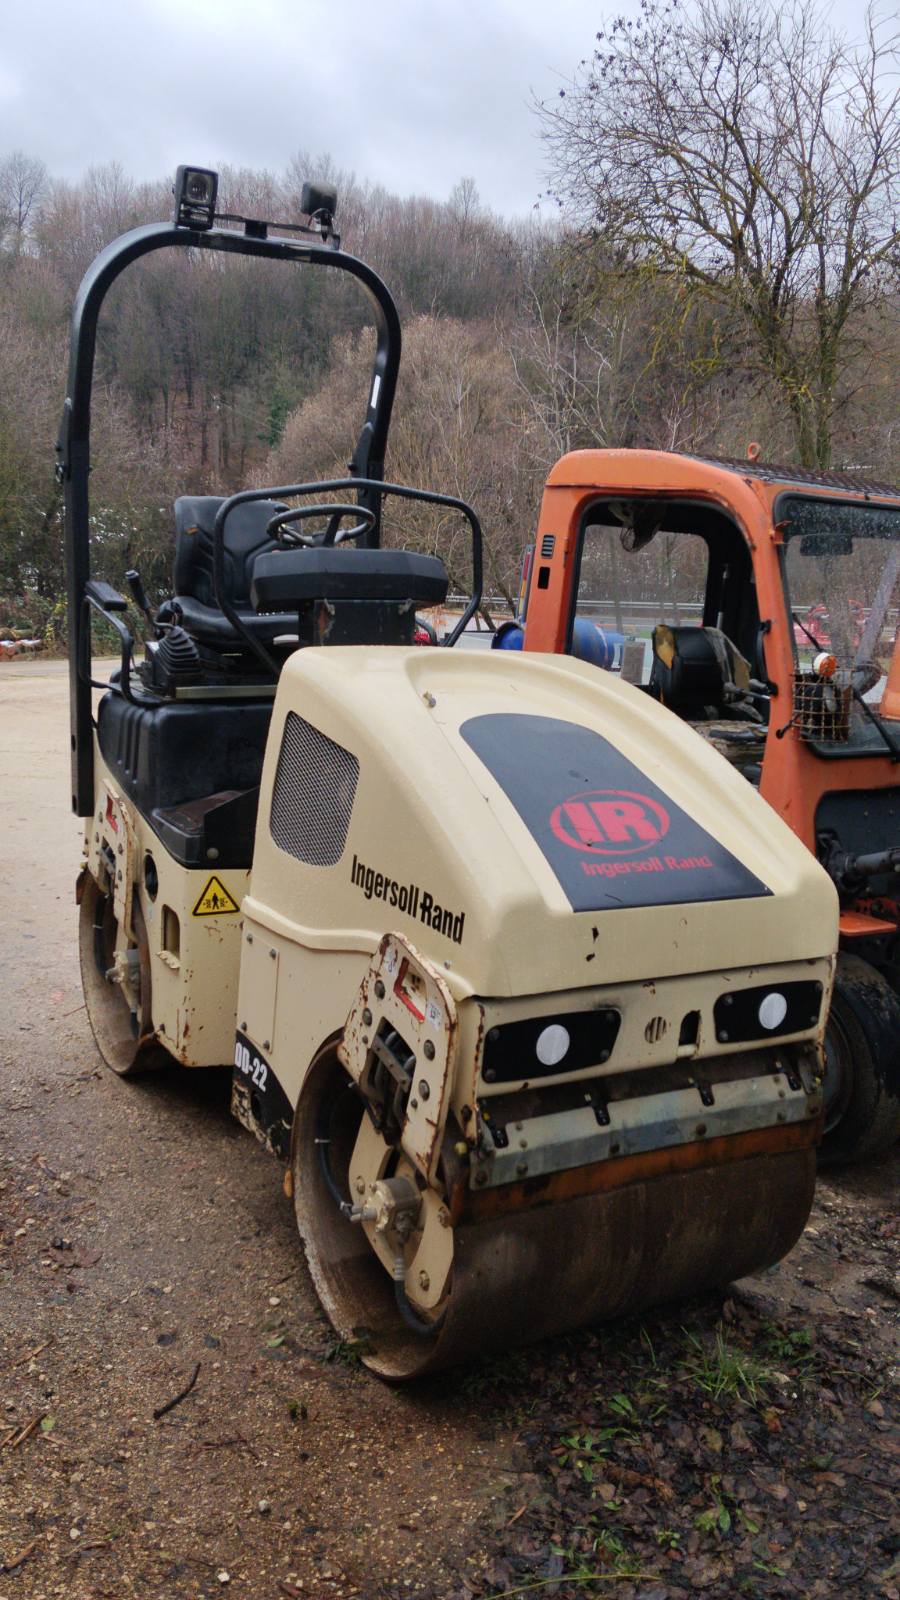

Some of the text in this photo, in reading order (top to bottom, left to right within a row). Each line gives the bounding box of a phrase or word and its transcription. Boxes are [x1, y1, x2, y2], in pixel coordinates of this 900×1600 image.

[562, 801, 661, 843] IR
[580, 854, 713, 878] Ingersoll Rand
[351, 854, 465, 945] Ingersoll Rand
